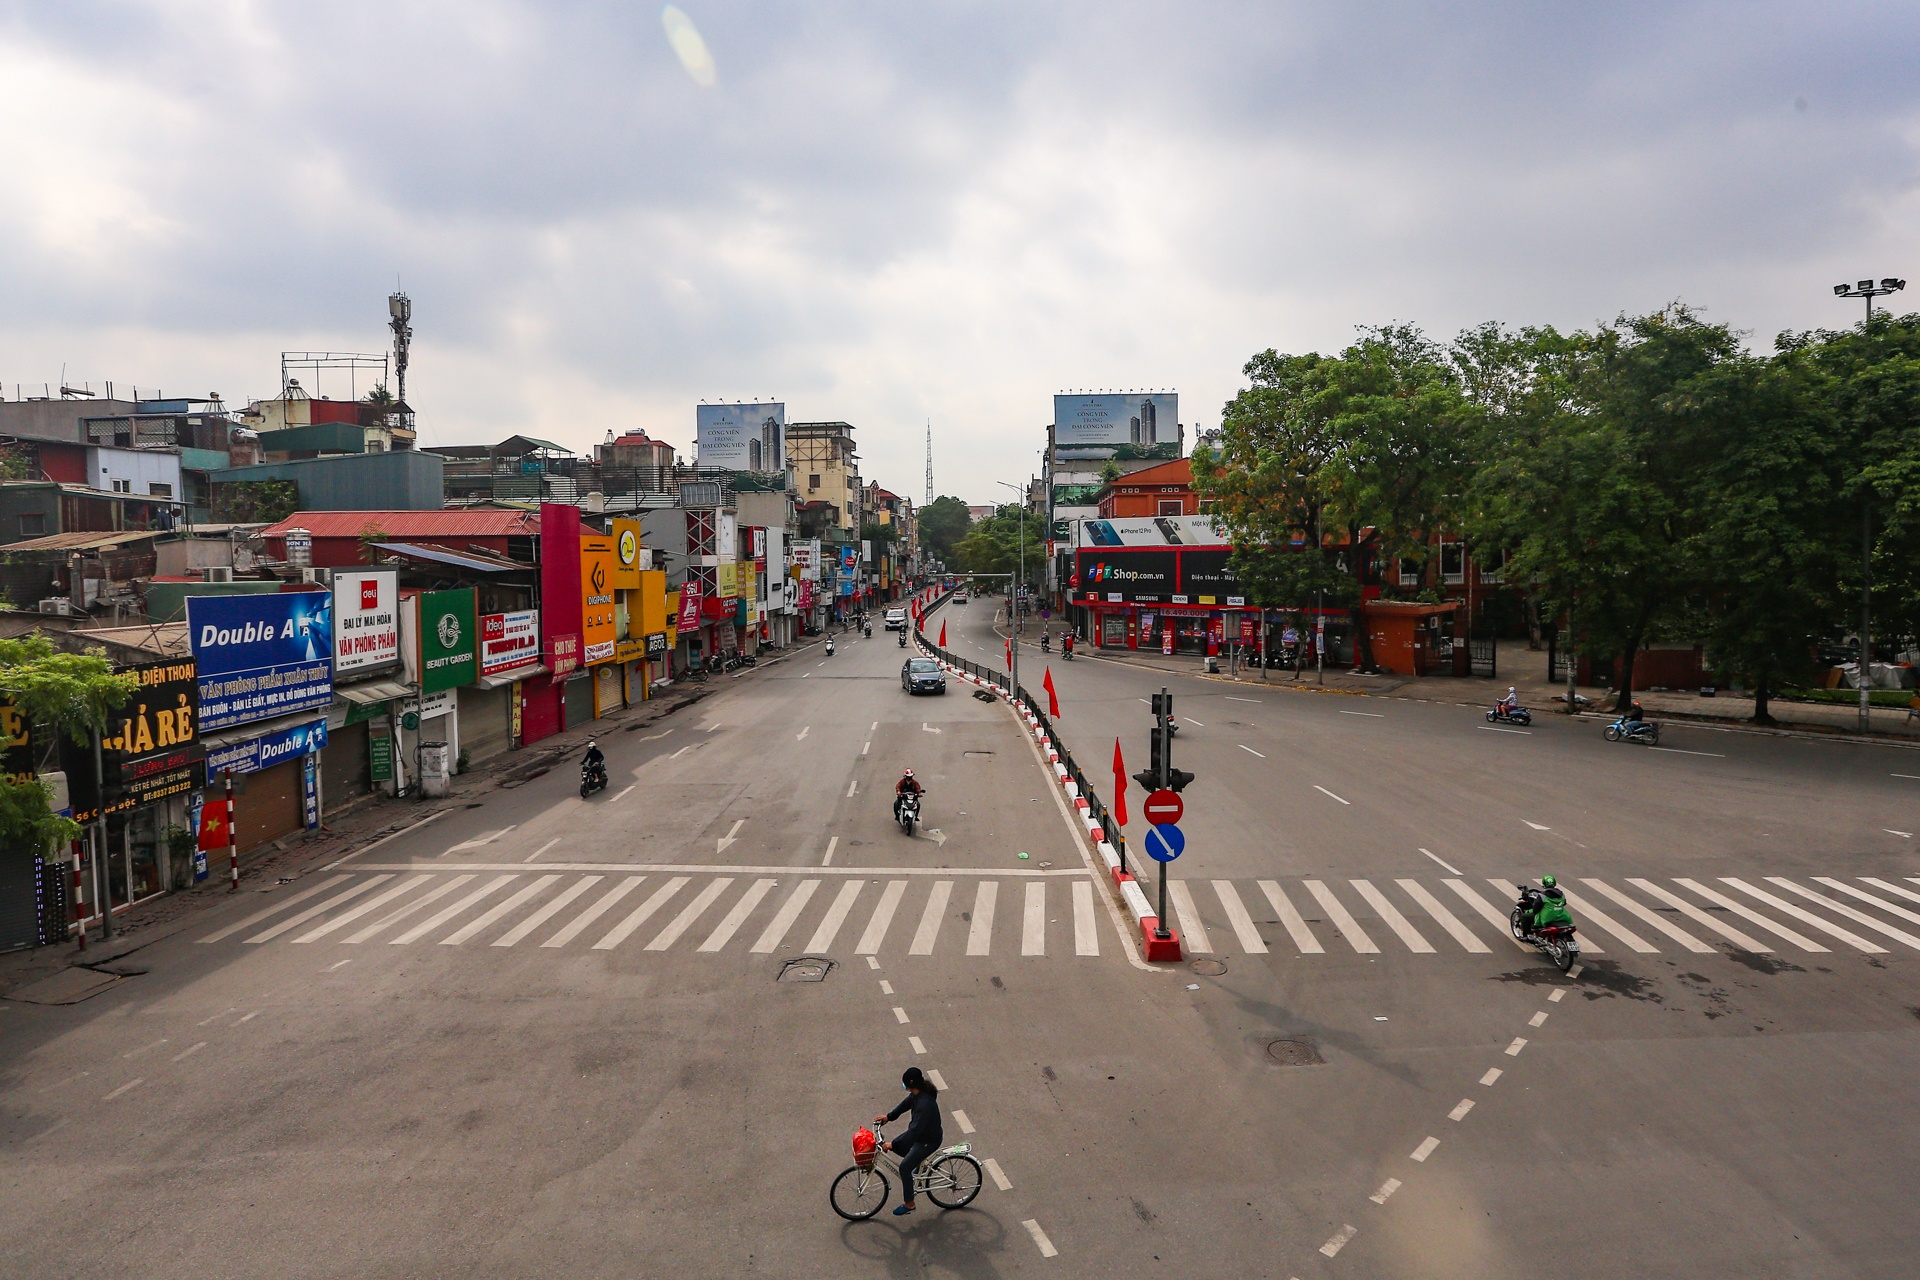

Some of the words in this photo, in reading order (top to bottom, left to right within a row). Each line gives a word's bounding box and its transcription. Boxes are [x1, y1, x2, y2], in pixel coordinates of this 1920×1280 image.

[362, 589, 377, 599] deli
[588, 595, 612, 606] DIGIPHONE
[343, 617, 354, 630] ĐẠI
[355, 614, 362, 628] LÝ
[364, 615, 375, 626] MAI
[376, 611, 392, 625] HOÀN
[486, 618, 503, 632] idea
[200, 620, 274, 648] Double
[280, 618, 295, 639] A
[339, 635, 353, 656] VĂN
[355, 632, 376, 653] PHÒNG
[378, 626, 396, 649] PHẨM
[554, 641, 564, 655] CHO
[564, 636, 577, 654] THUÊ
[426, 657, 449, 670] BEAUTY
[450, 652, 473, 665] GARDEN
[143, 667, 165, 687] ĐIỆN
[167, 664, 194, 682] THOẠI
[200, 680, 223, 700] VĂN
[224, 676, 257, 696] PHÒNG
[258, 667, 283, 690] PHẨM
[284, 667, 308, 685] XUÂN
[308, 662, 329, 681] THỦY
[198, 705, 212, 718] BÁN
[212, 702, 229, 716] BUÔN
[232, 698, 246, 711] BÁN
[156, 694, 193, 747] RẺ
[261, 736, 302, 760] Double
[305, 730, 314, 746] A
[168, 784, 179, 792] 283
[180, 780, 191, 790] 222
